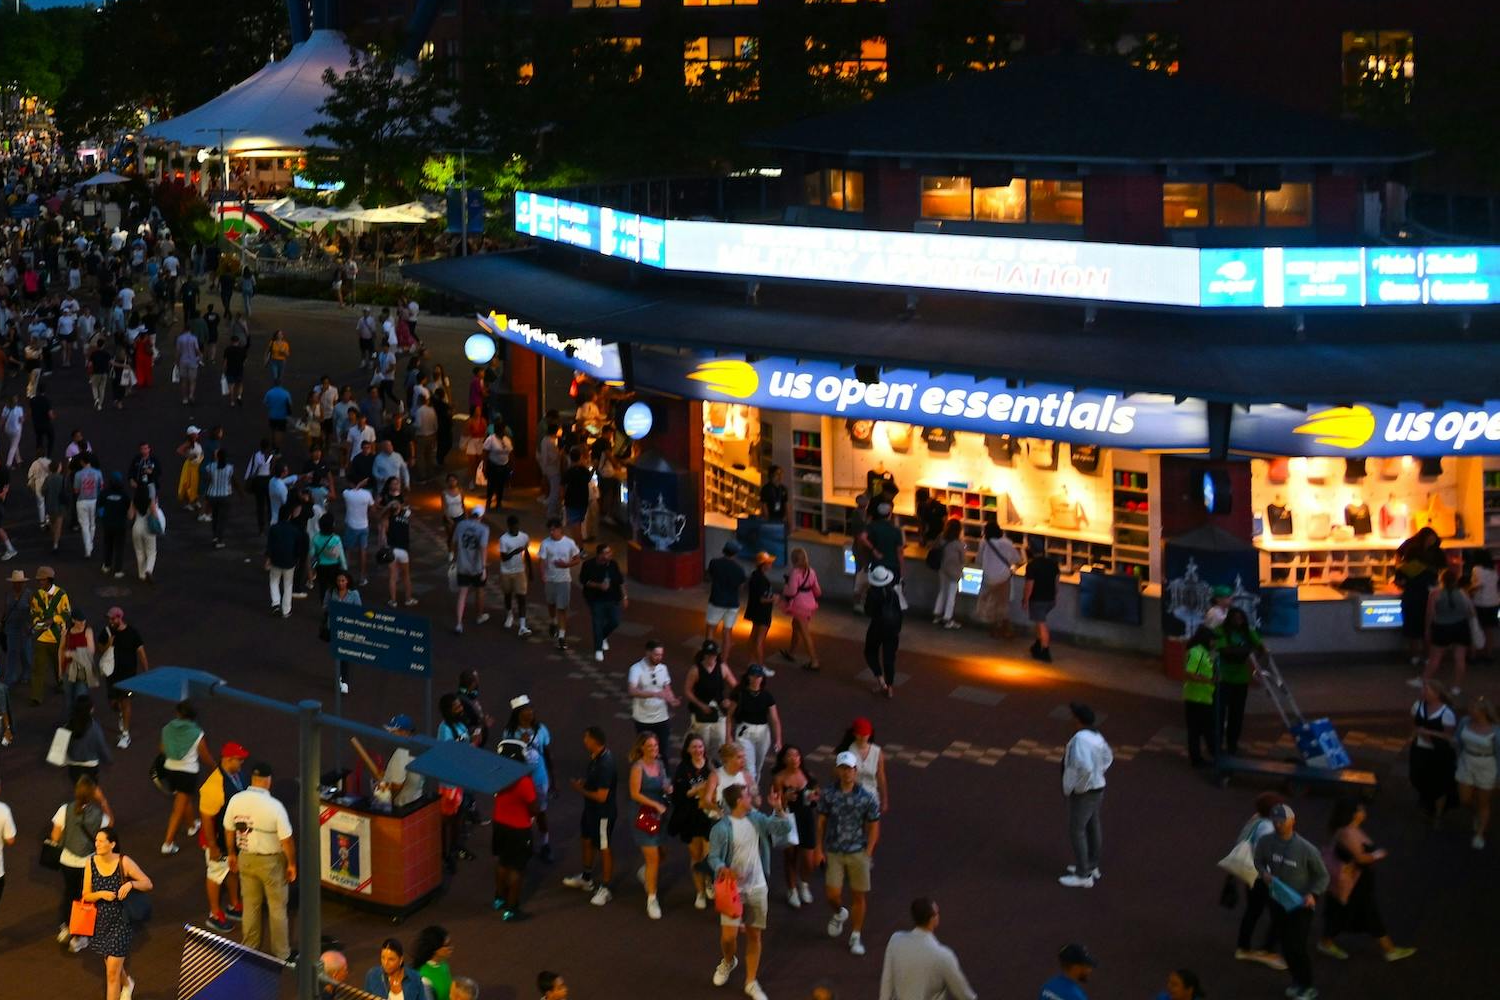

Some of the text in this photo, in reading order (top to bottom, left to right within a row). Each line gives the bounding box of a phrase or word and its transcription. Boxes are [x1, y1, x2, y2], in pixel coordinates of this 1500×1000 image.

[769, 371, 1137, 434] us open essentials
[1384, 411, 1435, 442] us
